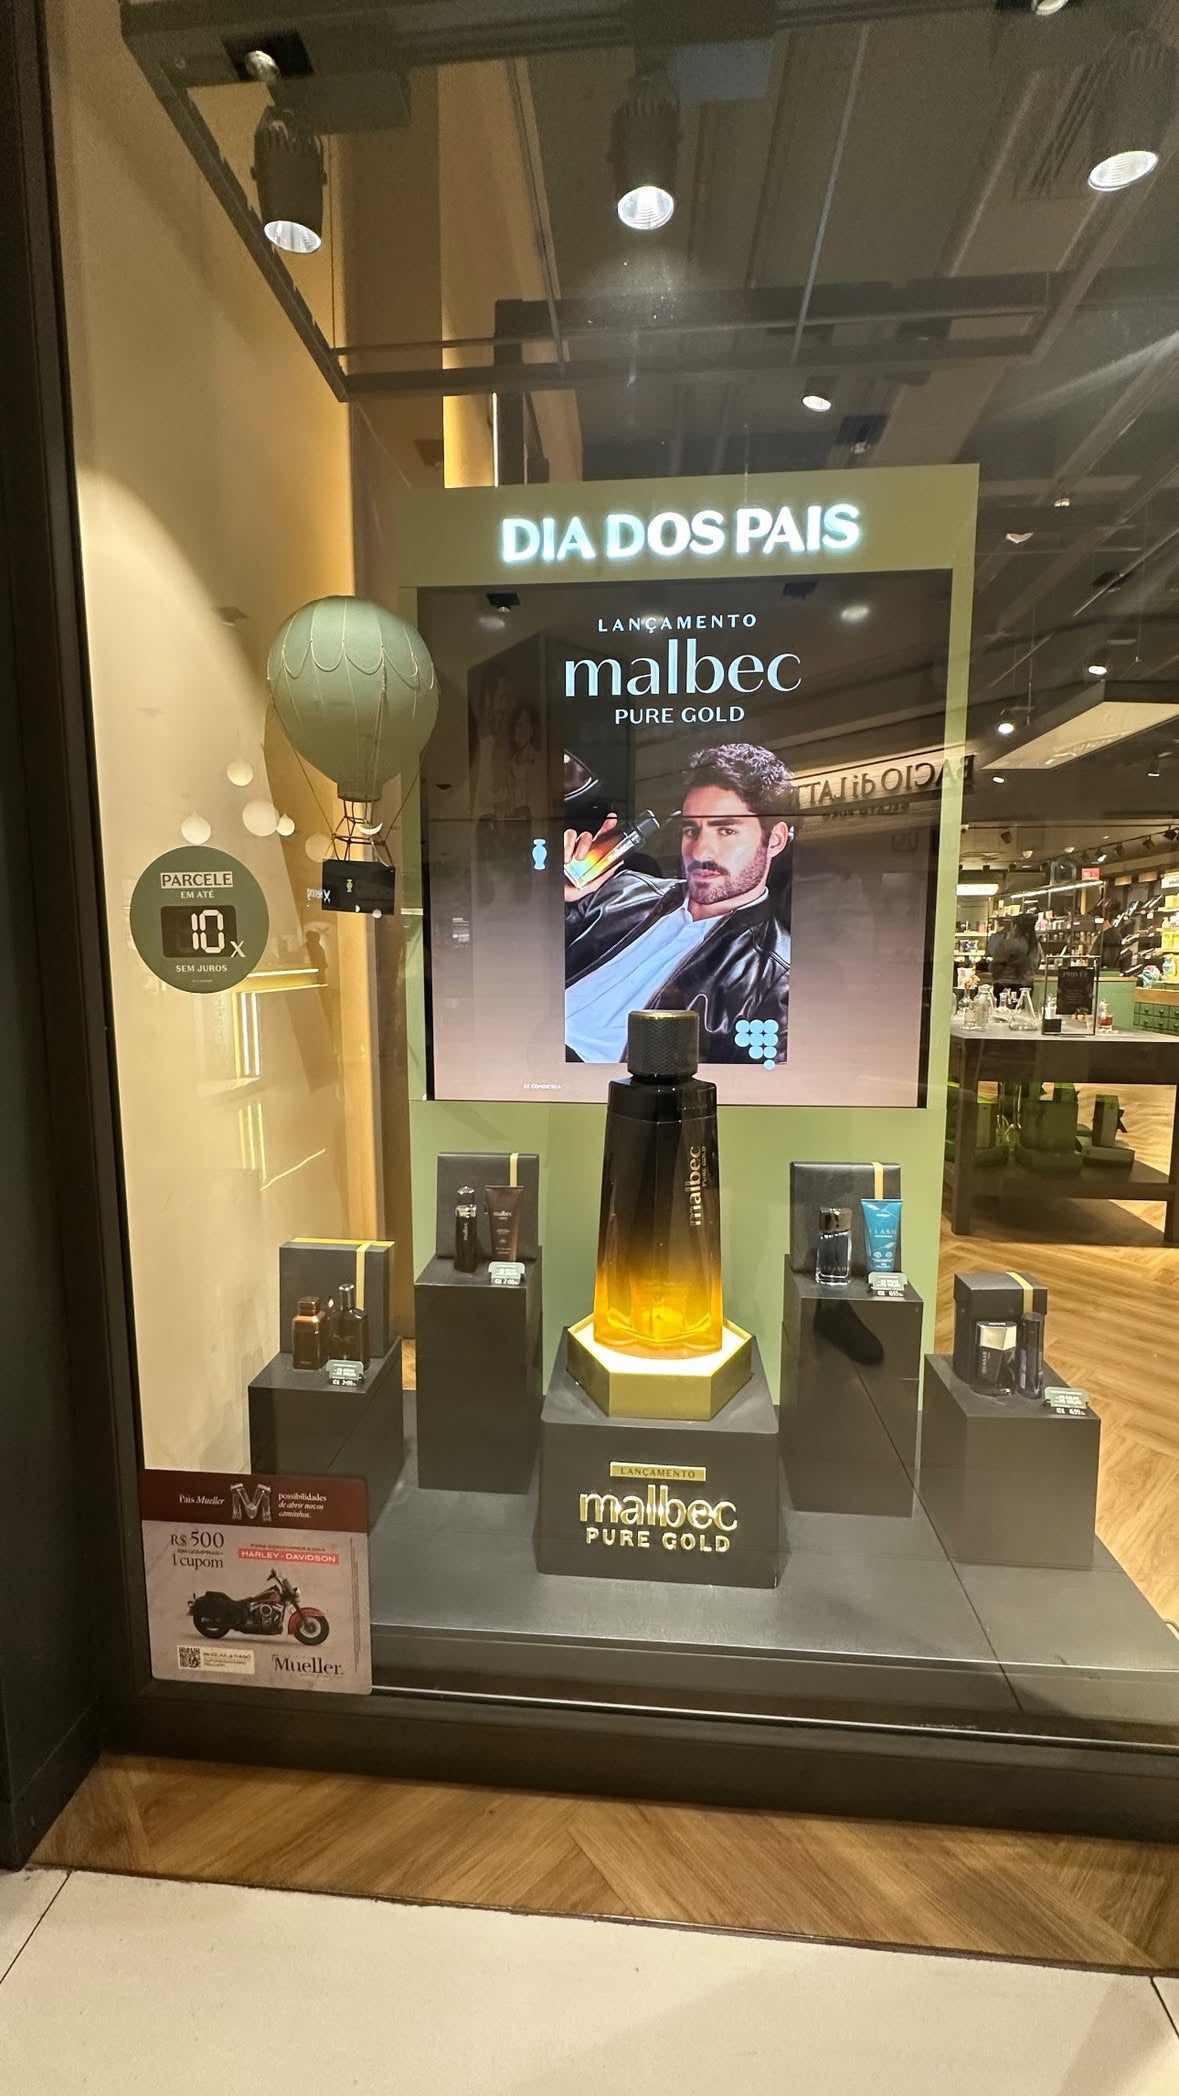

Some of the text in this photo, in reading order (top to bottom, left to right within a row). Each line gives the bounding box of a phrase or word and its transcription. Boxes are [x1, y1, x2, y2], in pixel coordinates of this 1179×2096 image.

[502, 504, 861, 563] DIA DOS PAIS
[598, 613, 757, 634] LANÇAMENTO
[564, 638, 802, 698] malbec
[615, 705, 745, 725] PURE GOLD
[162, 873, 232, 887] PARCELE
[180, 889, 215, 899] EM ATÉ
[197, 964, 228, 972] JUROS
[684, 1145, 702, 1226] malbec
[620, 1467, 696, 1479] LANÇAMENTO
[278, 1492, 327, 1502] possibilidades
[579, 1484, 738, 1531] malbec
[170, 1531, 225, 1548] R$ 500
[586, 1527, 731, 1552] PURE GOLD
[179, 1557, 224, 1570] cupom
